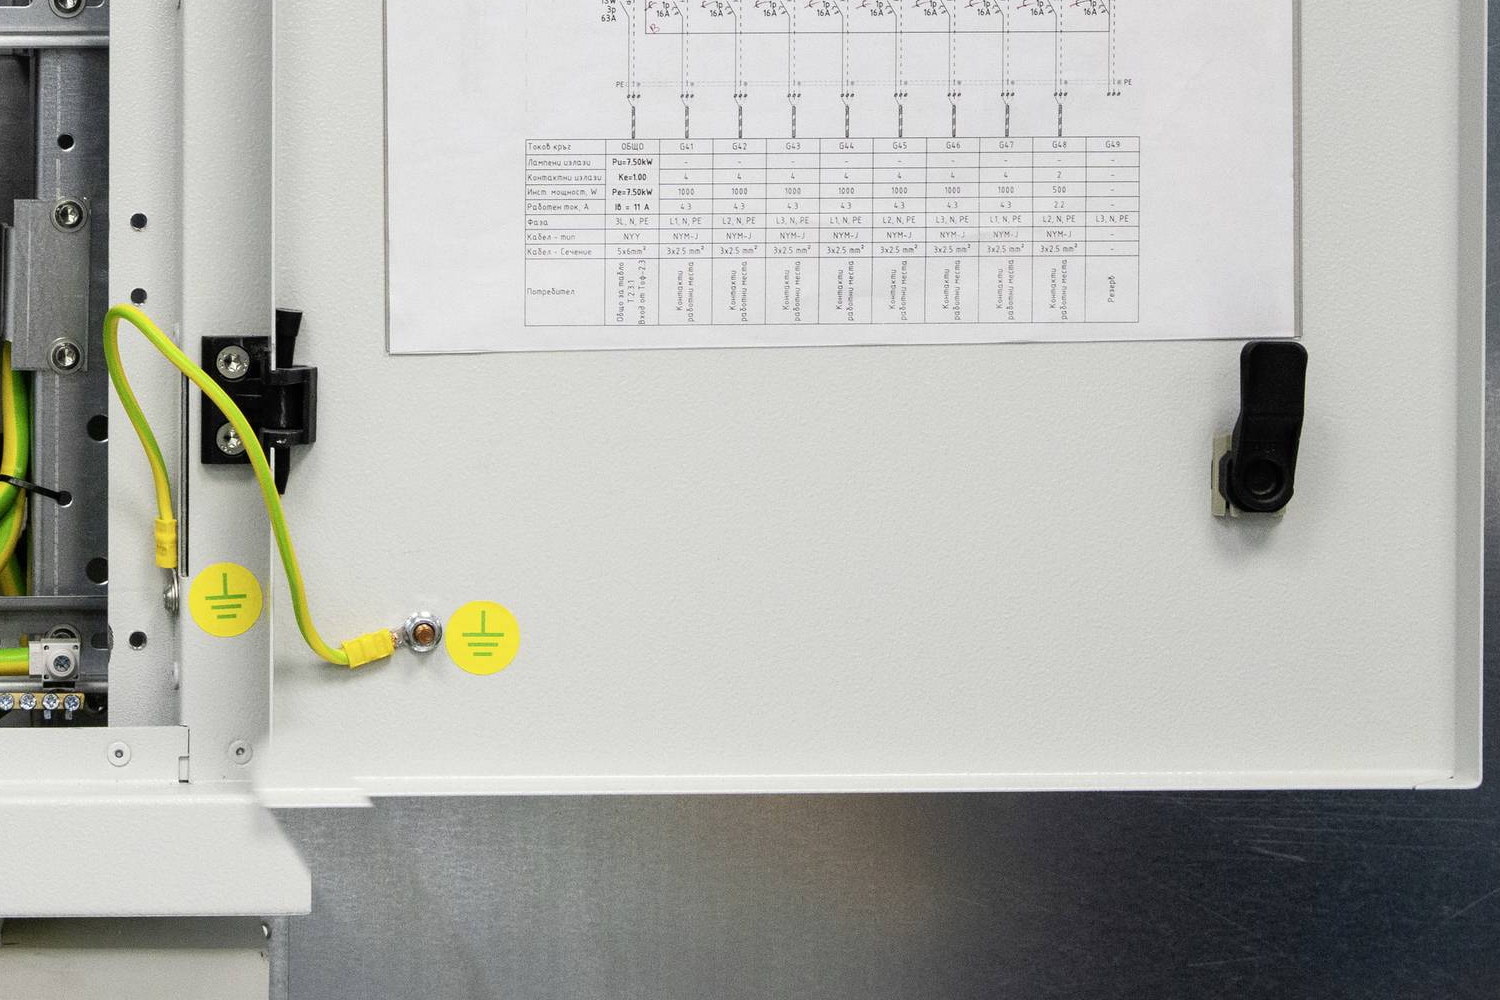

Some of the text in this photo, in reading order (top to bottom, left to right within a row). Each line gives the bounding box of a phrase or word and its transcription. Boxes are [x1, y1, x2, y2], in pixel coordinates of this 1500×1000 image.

[657, 8, 669, 17] 16A
[710, 8, 723, 17] 16A
[764, 8, 777, 16] 16A
[817, 8, 830, 16] 16A
[871, 7, 883, 16] 16A
[924, 7, 937, 16] 16A
[978, 7, 990, 15] 16A
[1031, 7, 1044, 15] 16A
[1084, 7, 1097, 15] 16A
[601, 13, 616, 22] 63A
[527, 142, 550, 151] Токов
[621, 143, 644, 151] ОБЩО
[786, 142, 801, 150] G43
[999, 141, 1014, 149] G47
[527, 157, 561, 166] Лампени
[527, 174, 572, 183] Контактни
[527, 202, 561, 210] Работен
[526, 232, 575, 241] Кабел тип
[526, 248, 551, 256] Кабел
[526, 288, 574, 296] Потребител
